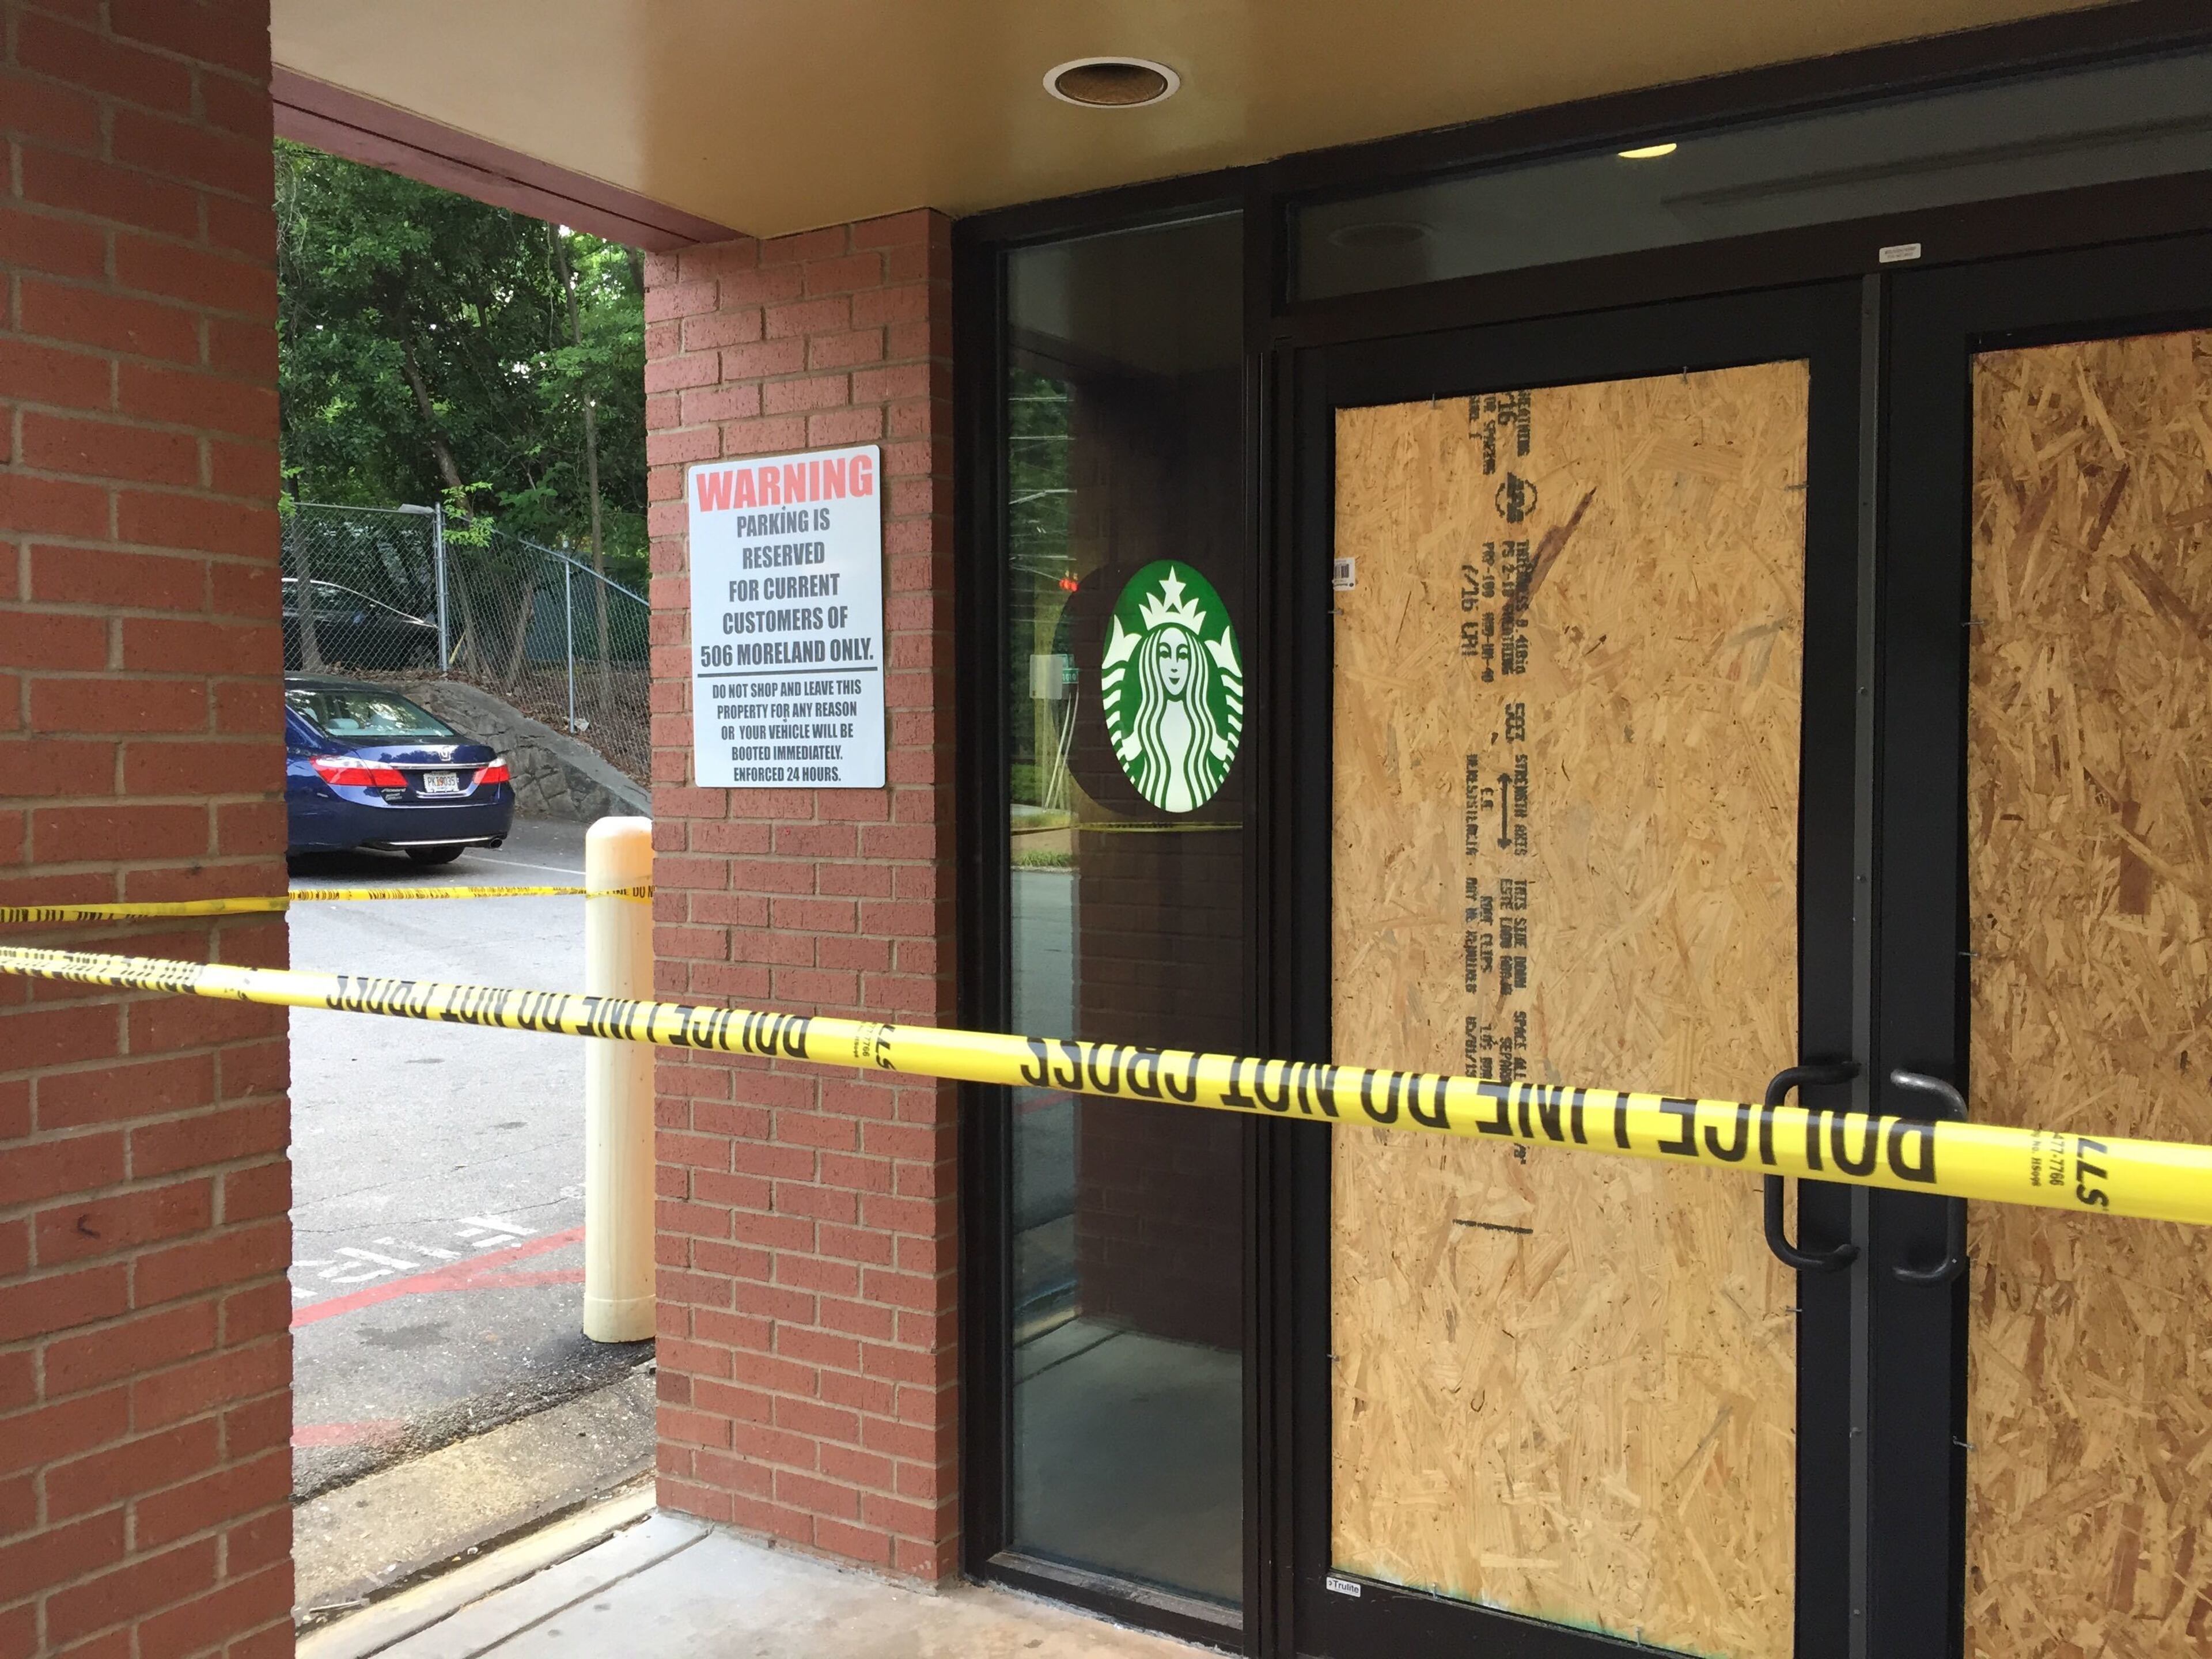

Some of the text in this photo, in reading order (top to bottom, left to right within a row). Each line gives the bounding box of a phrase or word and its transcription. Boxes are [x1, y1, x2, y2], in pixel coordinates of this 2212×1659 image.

[696, 454, 873, 512] WARNING
[737, 507, 831, 538] PARKING IS
[743, 541, 825, 569] RESERVED
[729, 573, 840, 603] FOR CURRENT
[722, 605, 848, 635] CUSTOMERS OF
[700, 638, 874, 668] 506 MORELAND ONLY.
[712, 679, 862, 699] DO NOT SHOP AND LEAVE THIS
[717, 701, 857, 719] PROPERTY FOR ANY REASON
[721, 723, 854, 740] OR YOUR VEHICLE WILL BE
[732, 745, 843, 762] BOOTED IMMEDIATELY.
[733, 766, 842, 782] ENFORCED 24 HOURS.
[575, 996, 661, 1043] LINE
[667, 1005, 810, 1059] POLICE
[1020, 1037, 1937, 1184] POLICE LINE DO NOT CROSS
[1332, 1580, 1359, 1593] Trulite
